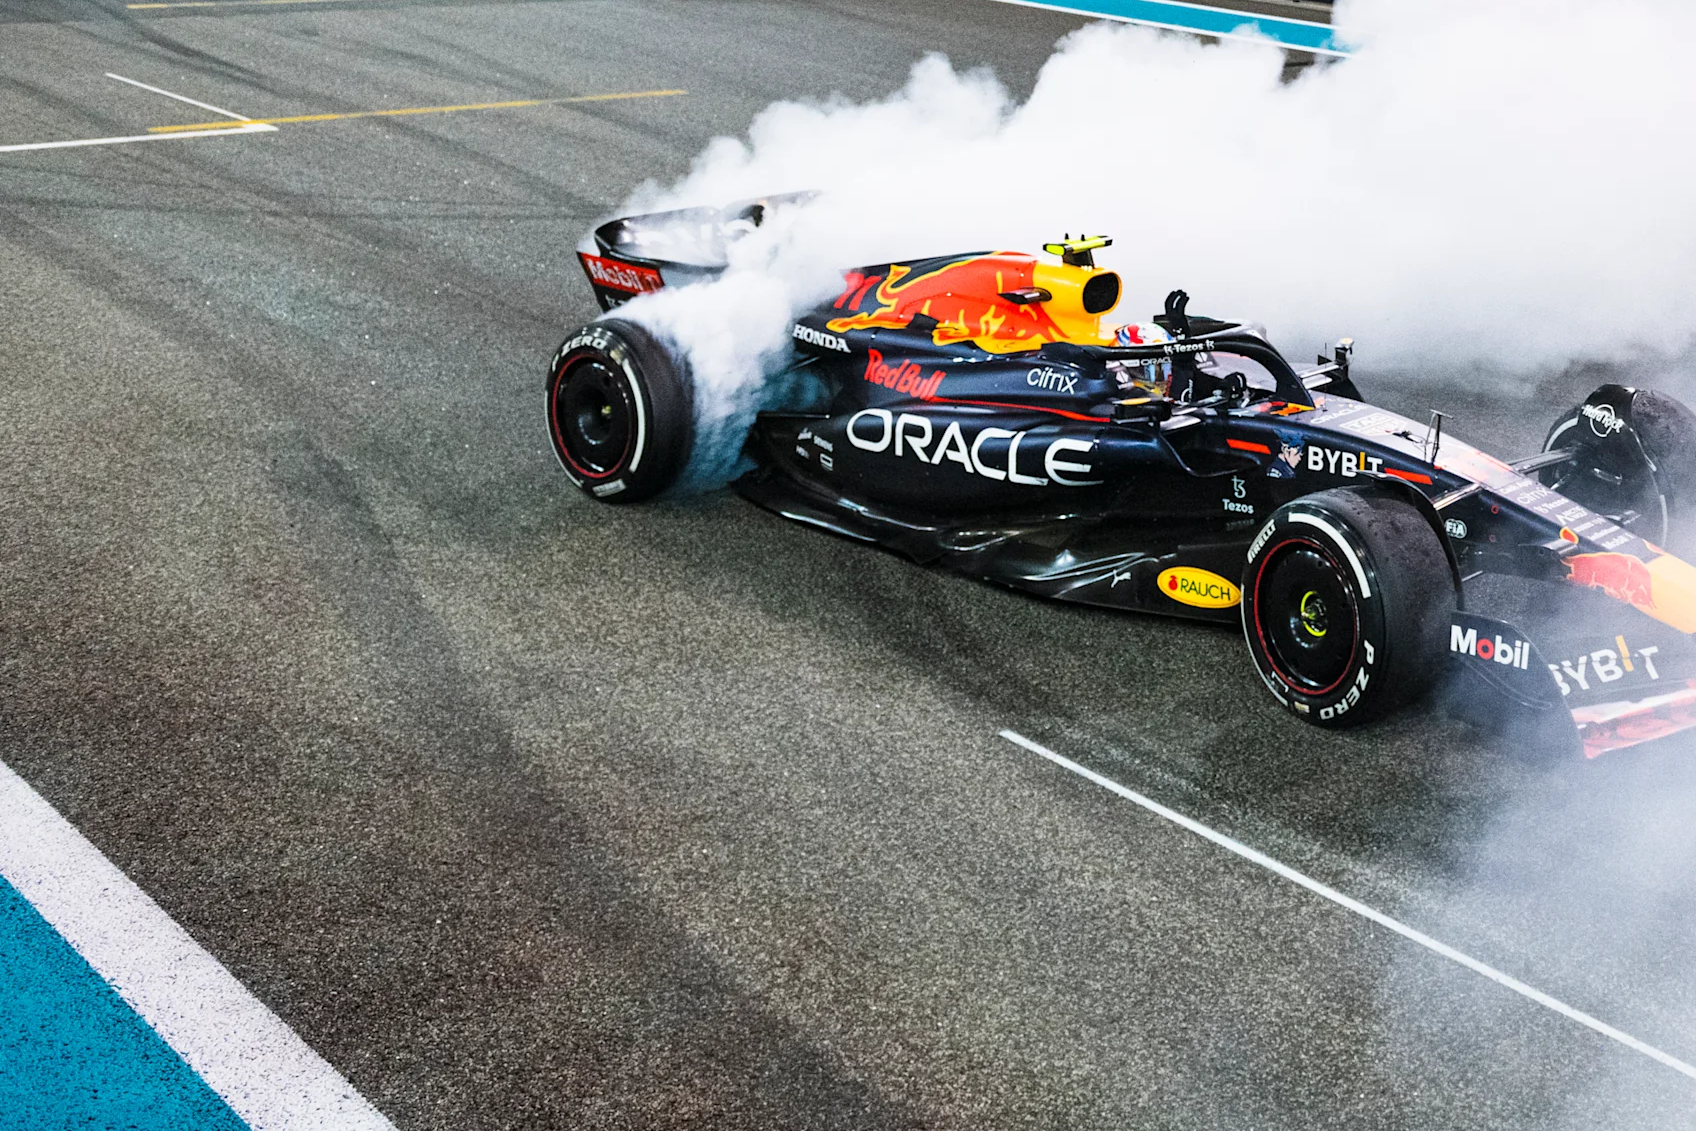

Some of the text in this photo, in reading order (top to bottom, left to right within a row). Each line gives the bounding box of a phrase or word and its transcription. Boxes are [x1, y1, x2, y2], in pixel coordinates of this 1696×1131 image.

[586, 258, 643, 290] Mobil
[561, 335, 608, 358] ZERO
[792, 323, 851, 353] HONDA
[1174, 342, 1203, 353] Tezos
[864, 348, 947, 400] Red Bull
[1140, 356, 1172, 366] ORACL
[1026, 366, 1079, 395] citrix
[846, 408, 1105, 487] ORACLE
[1307, 445, 1383, 478] BYBIT
[1222, 499, 1254, 514] Tezos
[1246, 519, 1276, 564] PIRELLI
[1446, 521, 1464, 536] FIA
[1180, 578, 1231, 601] RAUCH
[1450, 624, 1530, 670] Mobil
[1319, 639, 1375, 720] P ZERO
[1548, 635, 1660, 696] BYBIT
